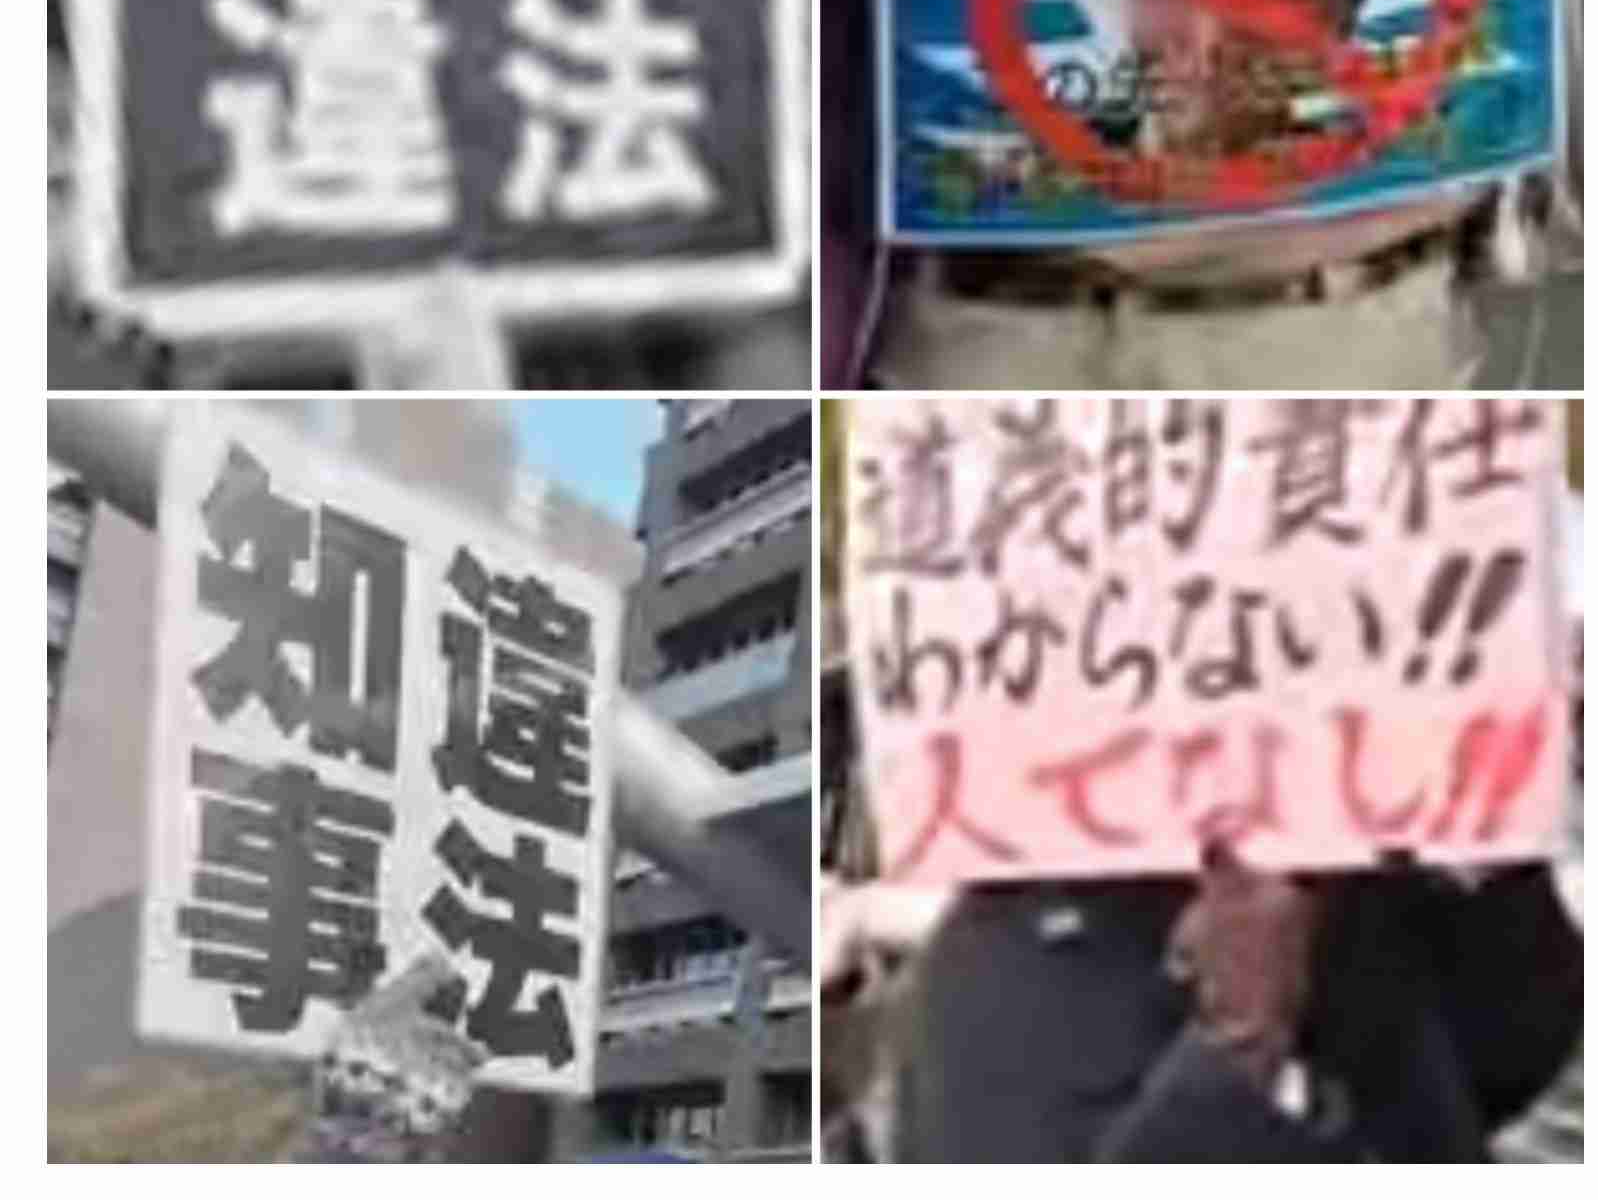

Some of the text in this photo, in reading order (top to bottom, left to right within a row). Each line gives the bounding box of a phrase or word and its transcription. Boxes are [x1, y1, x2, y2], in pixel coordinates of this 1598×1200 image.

[175, 440, 408, 1036] 知事
[424, 544, 598, 1072] 違法
[870, 548, 1526, 710] わからない!!
